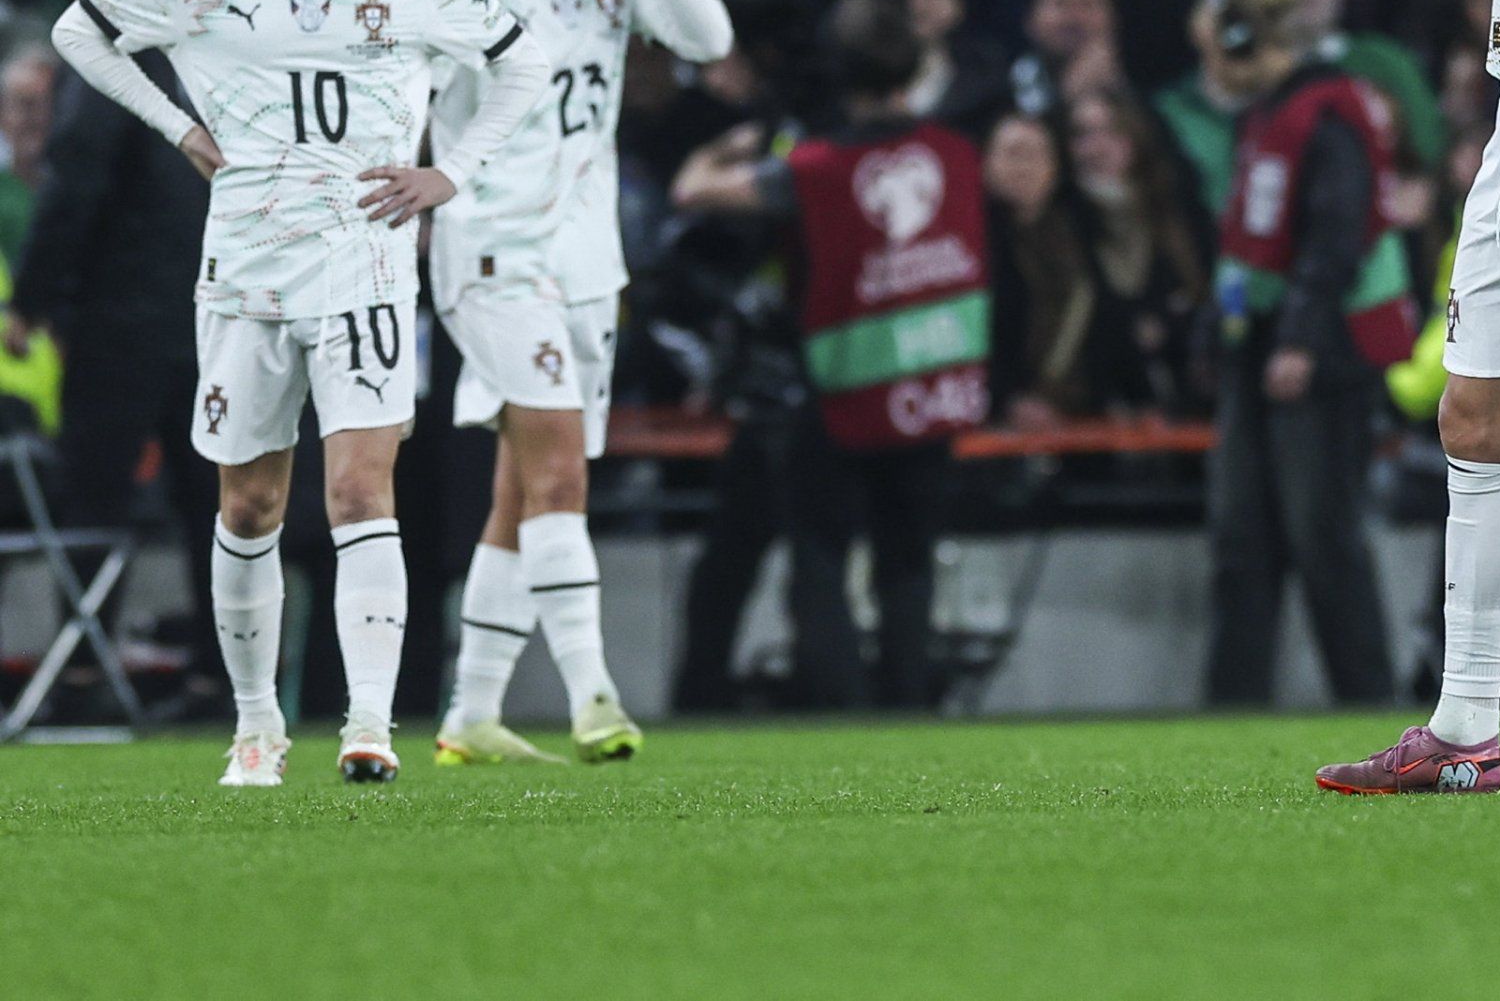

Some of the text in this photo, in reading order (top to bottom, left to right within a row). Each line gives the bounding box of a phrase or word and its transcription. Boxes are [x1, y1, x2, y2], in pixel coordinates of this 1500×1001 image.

[287, 71, 348, 144] 10
[551, 63, 607, 137] 23
[339, 304, 399, 371] 10
